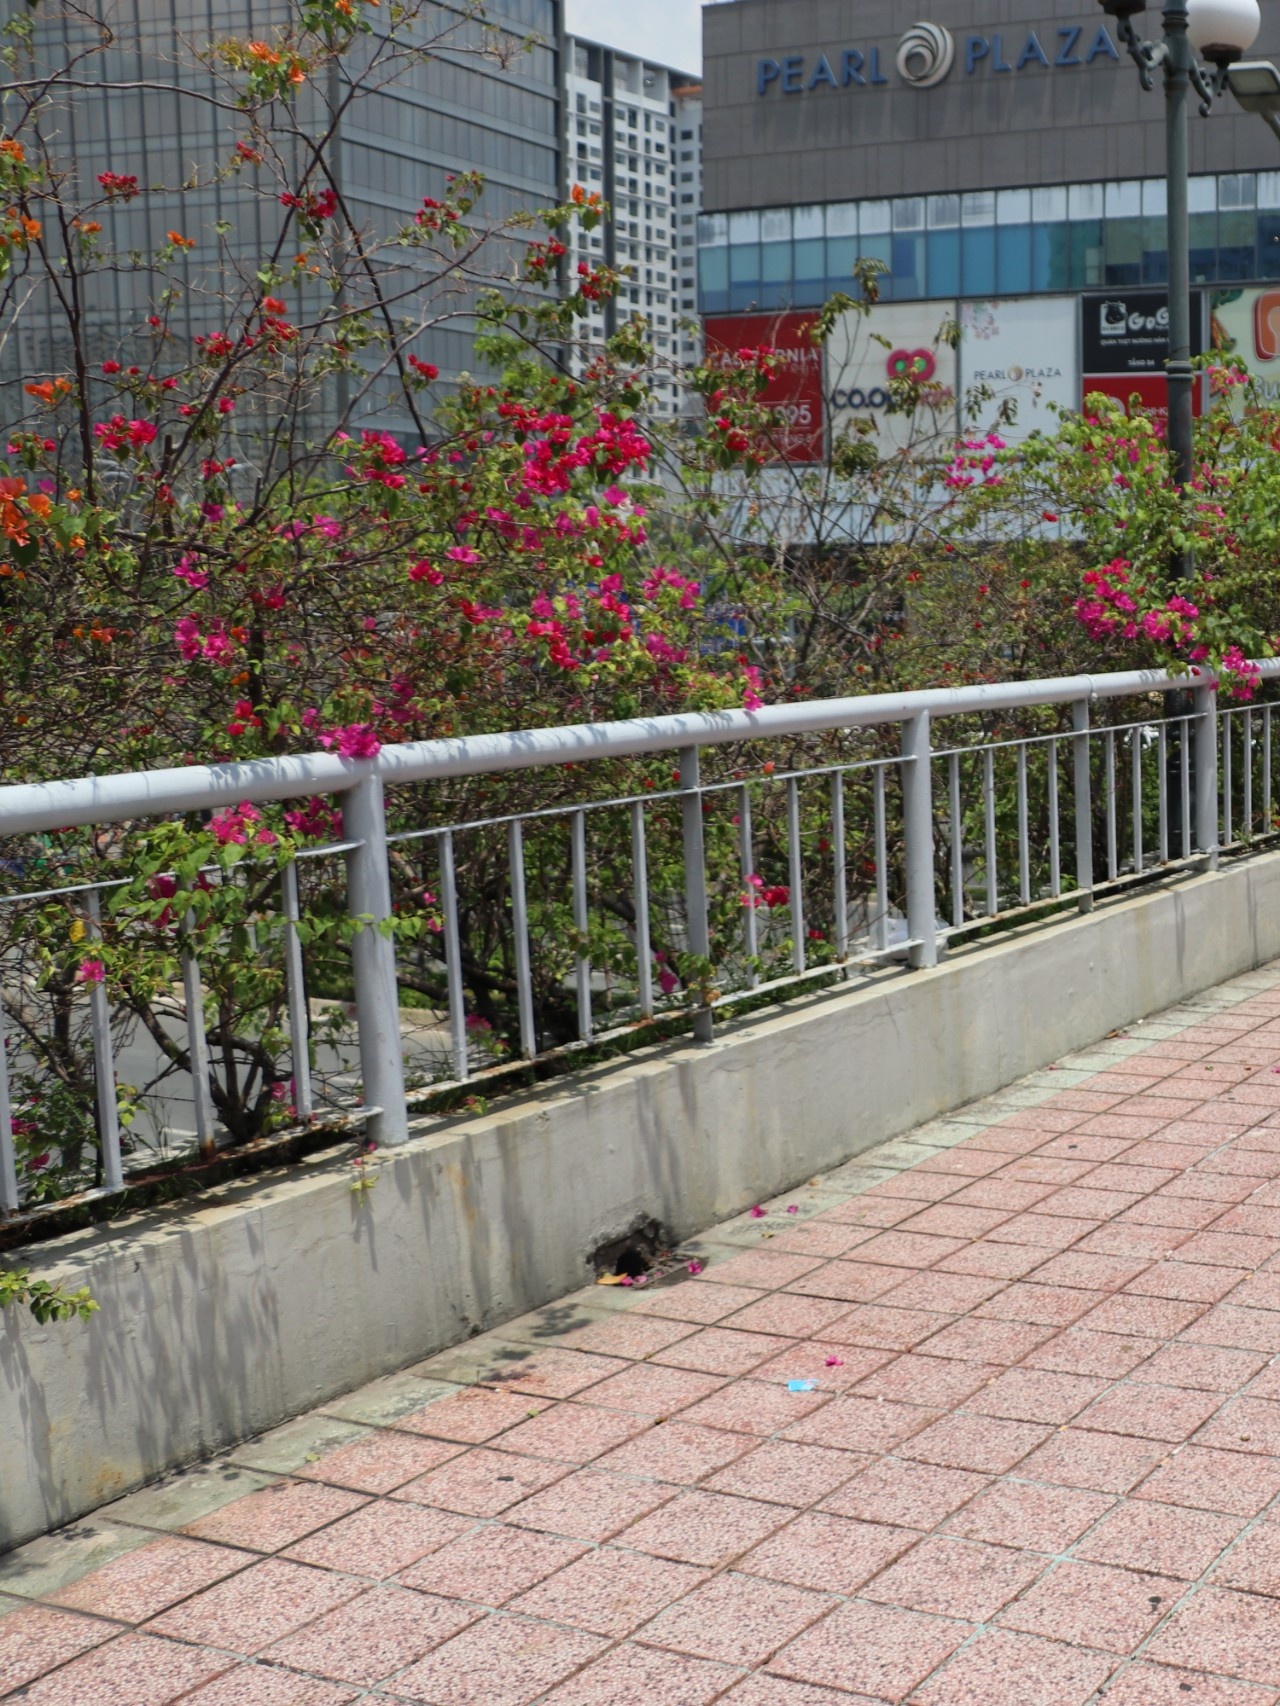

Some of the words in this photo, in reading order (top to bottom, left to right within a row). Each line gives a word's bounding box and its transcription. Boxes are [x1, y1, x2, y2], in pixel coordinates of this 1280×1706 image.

[756, 46, 888, 96] PEARL
[964, 23, 1120, 75] PLAZA
[974, 368, 1006, 380] PEARL
[1025, 367, 1062, 378] PLAZA
